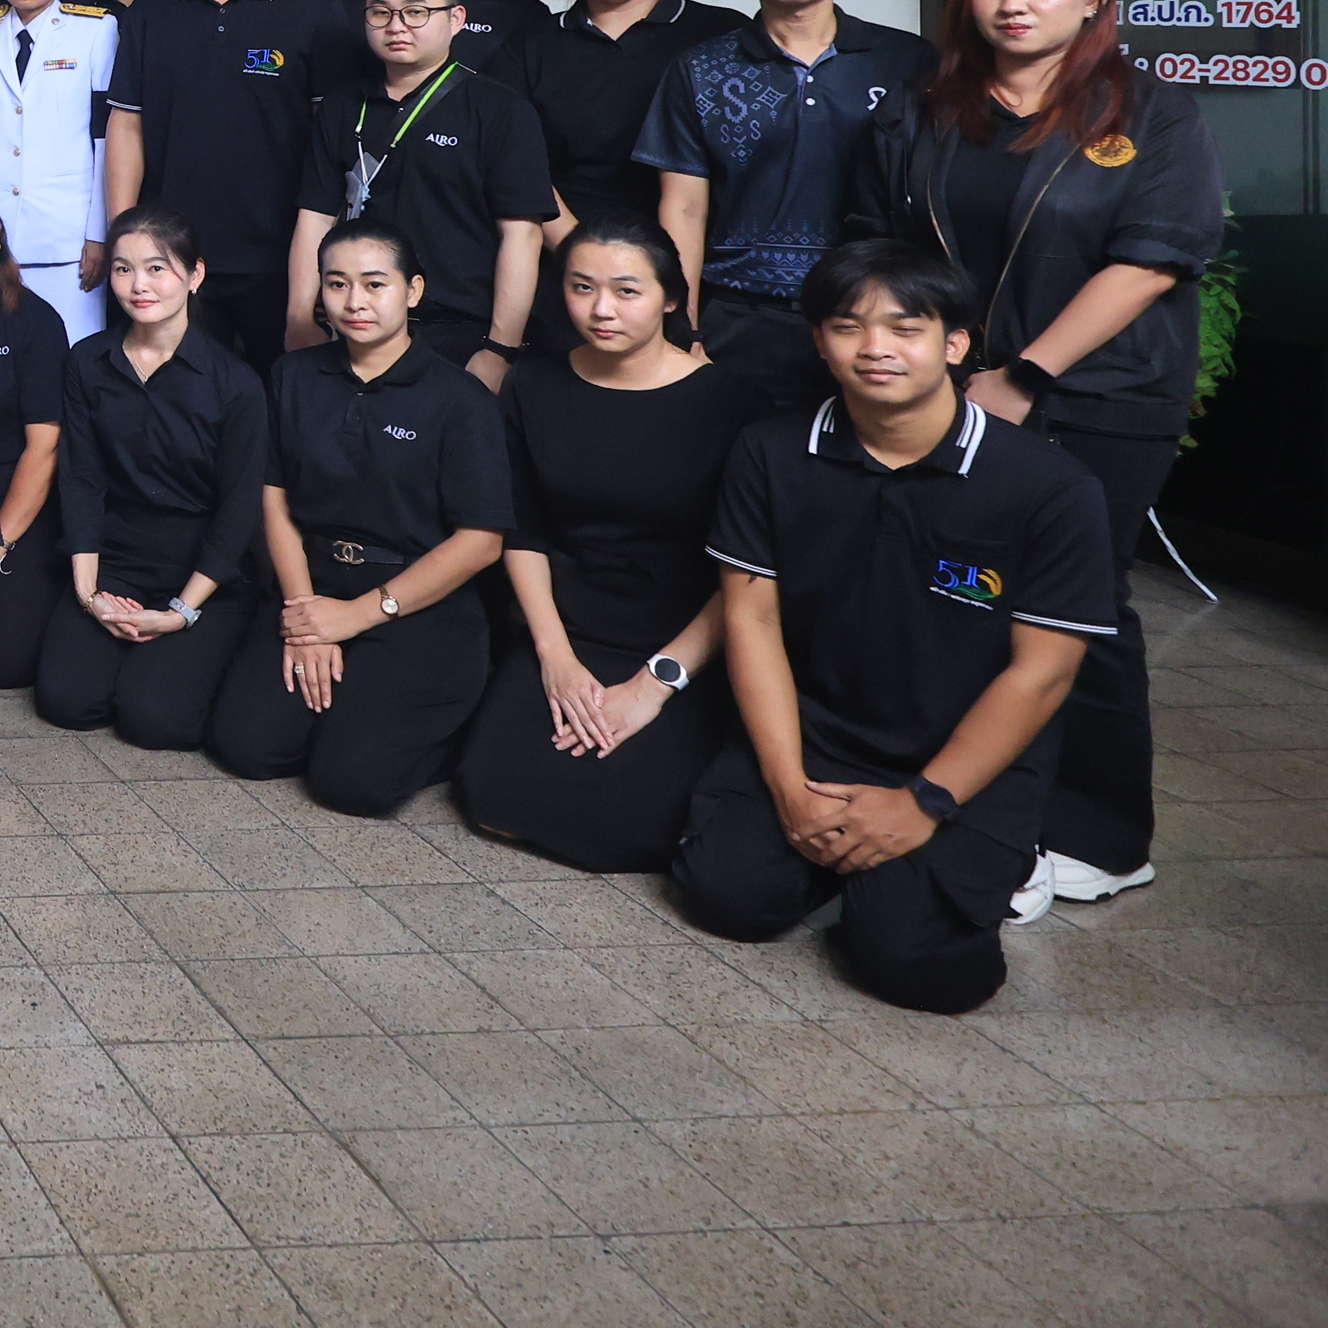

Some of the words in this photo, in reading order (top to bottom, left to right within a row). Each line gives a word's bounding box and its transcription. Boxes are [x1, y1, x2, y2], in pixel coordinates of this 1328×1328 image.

[1130, 0, 1211, 24] ส.ป.ก.
[1220, 1, 1296, 24] 1764
[1158, 56, 1292, 84] 02-2829
[425, 132, 458, 147] ALRO
[382, 423, 417, 441] ALRO
